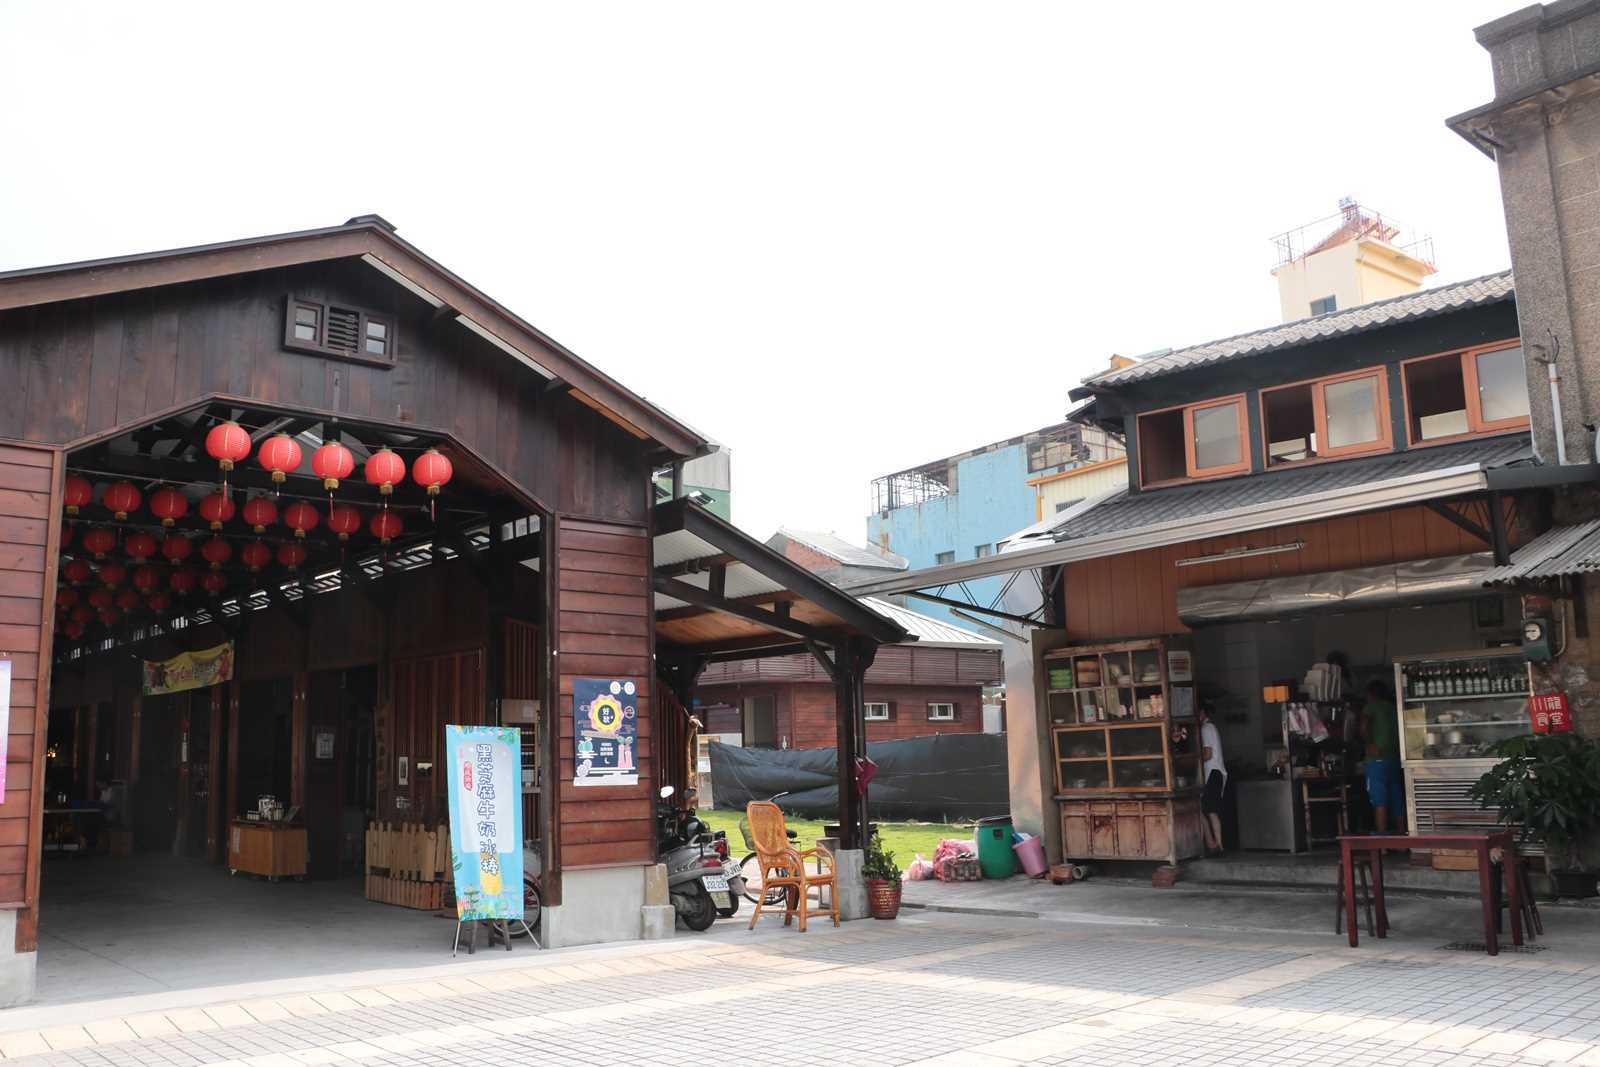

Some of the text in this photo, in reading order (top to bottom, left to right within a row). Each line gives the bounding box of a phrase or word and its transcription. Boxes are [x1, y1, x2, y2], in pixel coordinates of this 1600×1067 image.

[475, 743, 499, 876] 黑芝麻牛奶冰棒
